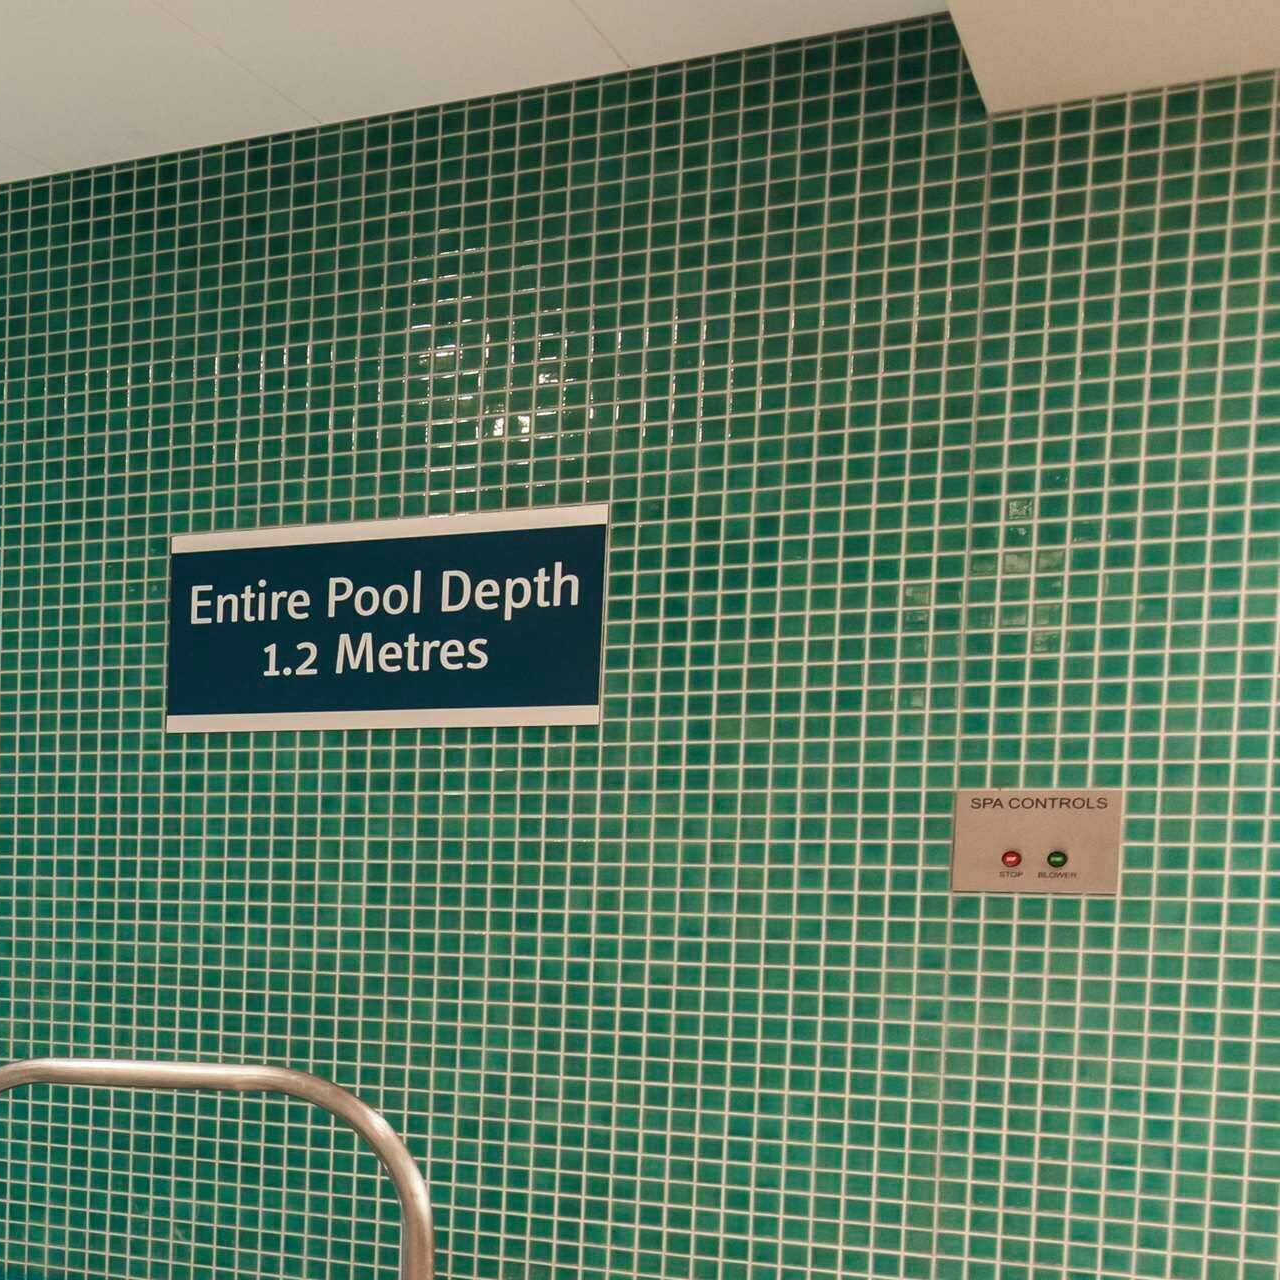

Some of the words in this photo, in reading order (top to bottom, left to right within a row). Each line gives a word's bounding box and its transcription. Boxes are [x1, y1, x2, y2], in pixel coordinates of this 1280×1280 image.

[190, 579, 311, 625] Entire
[328, 570, 422, 618] Pool
[441, 561, 580, 621] Depth
[263, 642, 318, 677] 1.2
[335, 632, 489, 674] Metres
[970, 797, 1004, 810] SPA
[1008, 797, 1108, 810] CONTROLS
[1038, 871, 1078, 879] BLOWER
